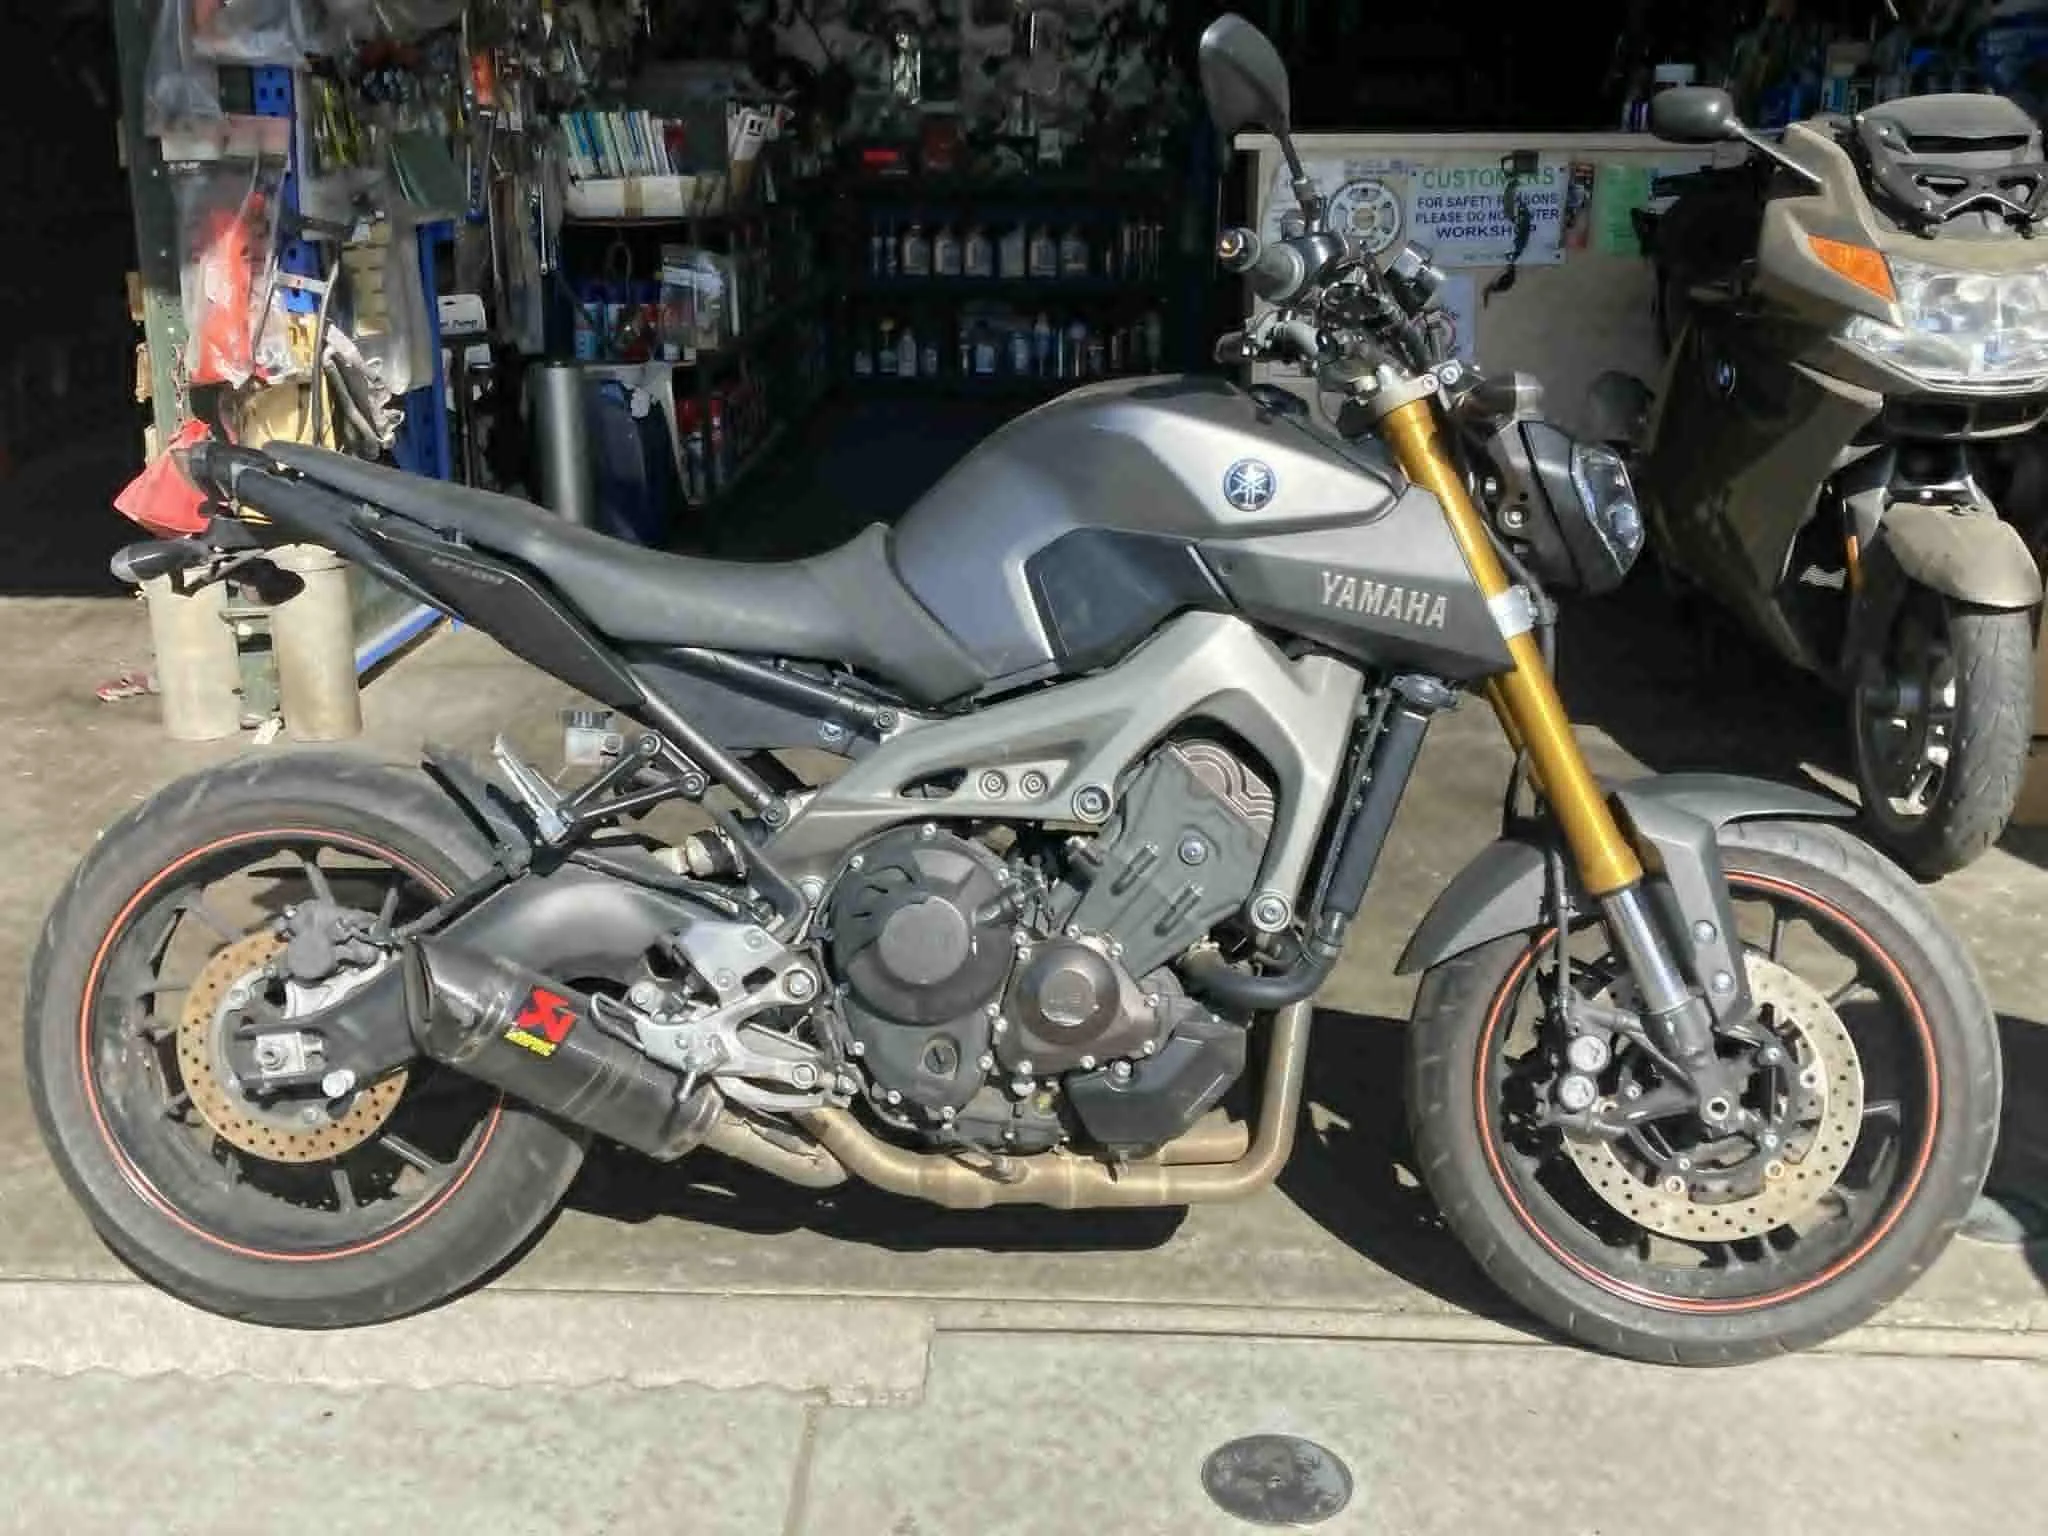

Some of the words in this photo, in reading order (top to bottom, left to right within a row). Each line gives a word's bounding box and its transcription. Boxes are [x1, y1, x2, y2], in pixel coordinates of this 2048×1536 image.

[1417, 195, 1443, 209] FOR
[1447, 194, 1492, 208] SAFETY
[1415, 211, 1464, 224] PLEASE
[1467, 211, 1486, 223] DO
[1489, 210, 1512, 223] NO
[1519, 208, 1560, 221] NTER
[1322, 571, 1448, 630] YAMAHA
